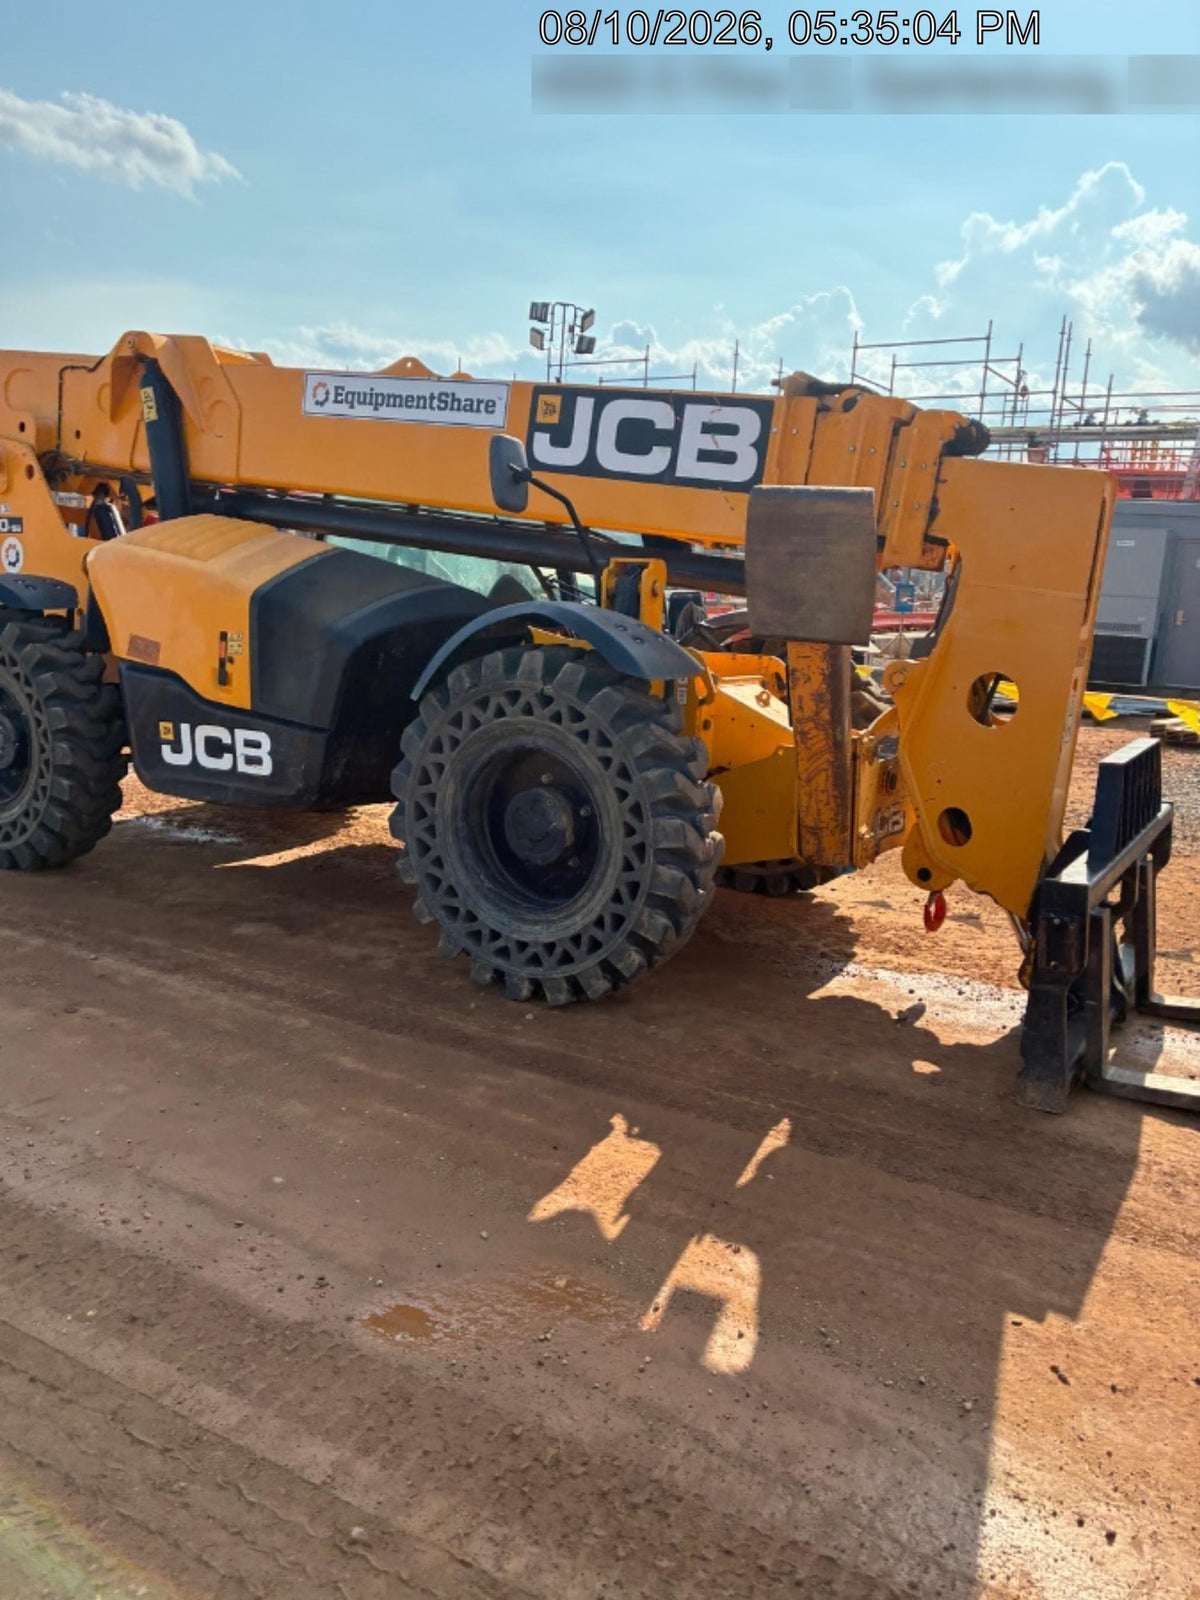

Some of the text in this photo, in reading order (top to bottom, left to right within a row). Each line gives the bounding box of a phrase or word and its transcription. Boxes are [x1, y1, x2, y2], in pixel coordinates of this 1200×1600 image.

[332, 385, 497, 415] EquipmentShare
[532, 395, 762, 483] JCB
[161, 722, 273, 776] JCB
[876, 804, 905, 838] CB
